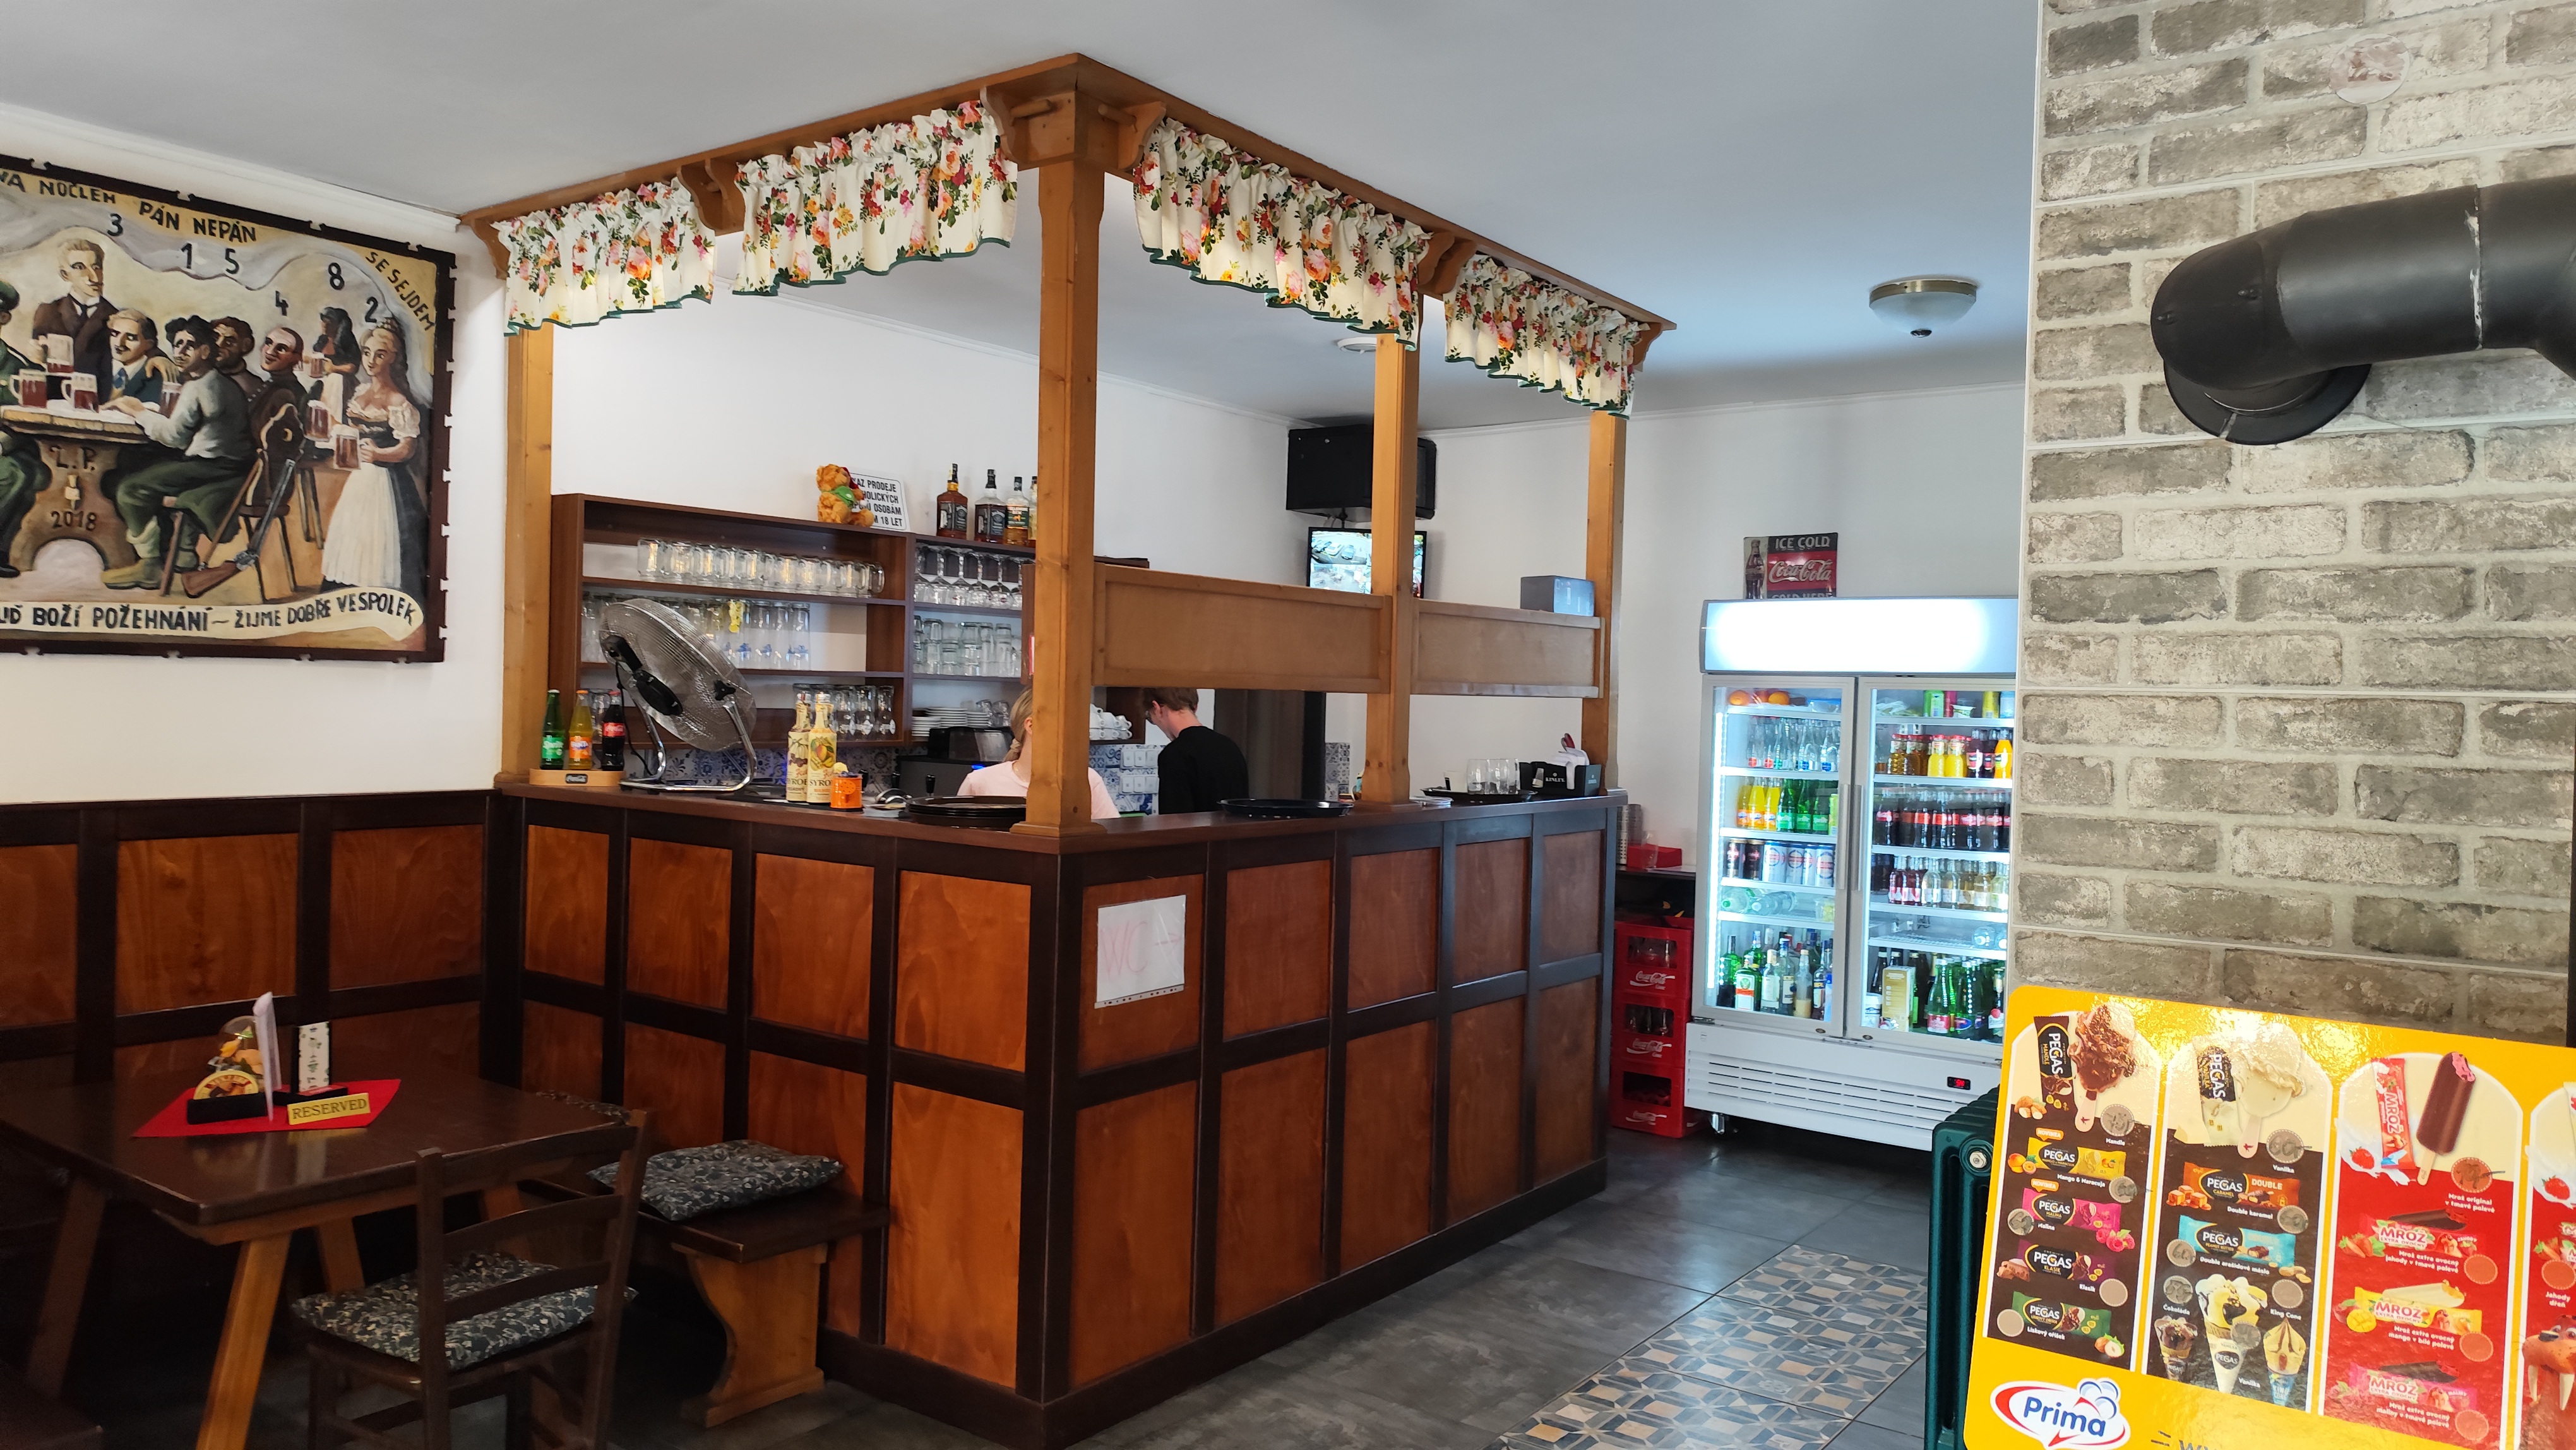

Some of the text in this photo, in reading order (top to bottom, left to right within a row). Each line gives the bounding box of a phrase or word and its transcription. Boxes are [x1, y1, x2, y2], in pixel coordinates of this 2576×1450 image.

[107, 213, 124, 237] 3
[181, 243, 193, 269] 1
[225, 248, 239, 274] 5
[139, 201, 179, 231] PÁN
[193, 217, 257, 243] NEPÁN
[365, 251, 390, 272] SE
[387, 268, 436, 331] SEJDEM
[328, 262, 345, 291] 8
[275, 291, 289, 316] 4
[365, 296, 378, 323] 2
[868, 480, 897, 492] PRODEJE
[874, 503, 902, 515] OSOBÁM
[51, 510, 97, 531] 2018
[881, 517, 889, 525] 18
[891, 517, 902, 527] LET
[1775, 536, 1830, 550] ICE COLD
[1769, 560, 1833, 583] Coca-Cola
[33, 604, 83, 627] BOŽÍ
[93, 604, 213, 631] POŽEHNÁNÍ
[235, 609, 282, 628] ŽIJME
[288, 598, 331, 624] DOBŘE
[1100, 921, 1147, 980] WC
[2049, 1033, 2063, 1074] PEGAS
[2209, 1053, 2226, 1098] PEGAS
[292, 1098, 367, 1120] RESERVED
[2044, 1149, 2075, 1163] PEGAS
[2057, 1174, 2075, 1182] Mango
[2207, 1177, 2243, 1192] PEGAS
[2251, 1178, 2282, 1190] DOUBLE
[2039, 1201, 2070, 1214] PEGAS
[2203, 1231, 2238, 1247] PEGAS
[2034, 1251, 2072, 1269] PEGAS
[2417, 1254, 2434, 1262] extra
[2079, 1284, 2096, 1292] Klasik
[2546, 1291, 2571, 1302] Jahody
[2030, 1305, 2060, 1320] PEGAS
[2412, 1329, 2429, 1338] extra
[2215, 1353, 2238, 1364] PEGAS
[2024, 1396, 2106, 1437] Prima
